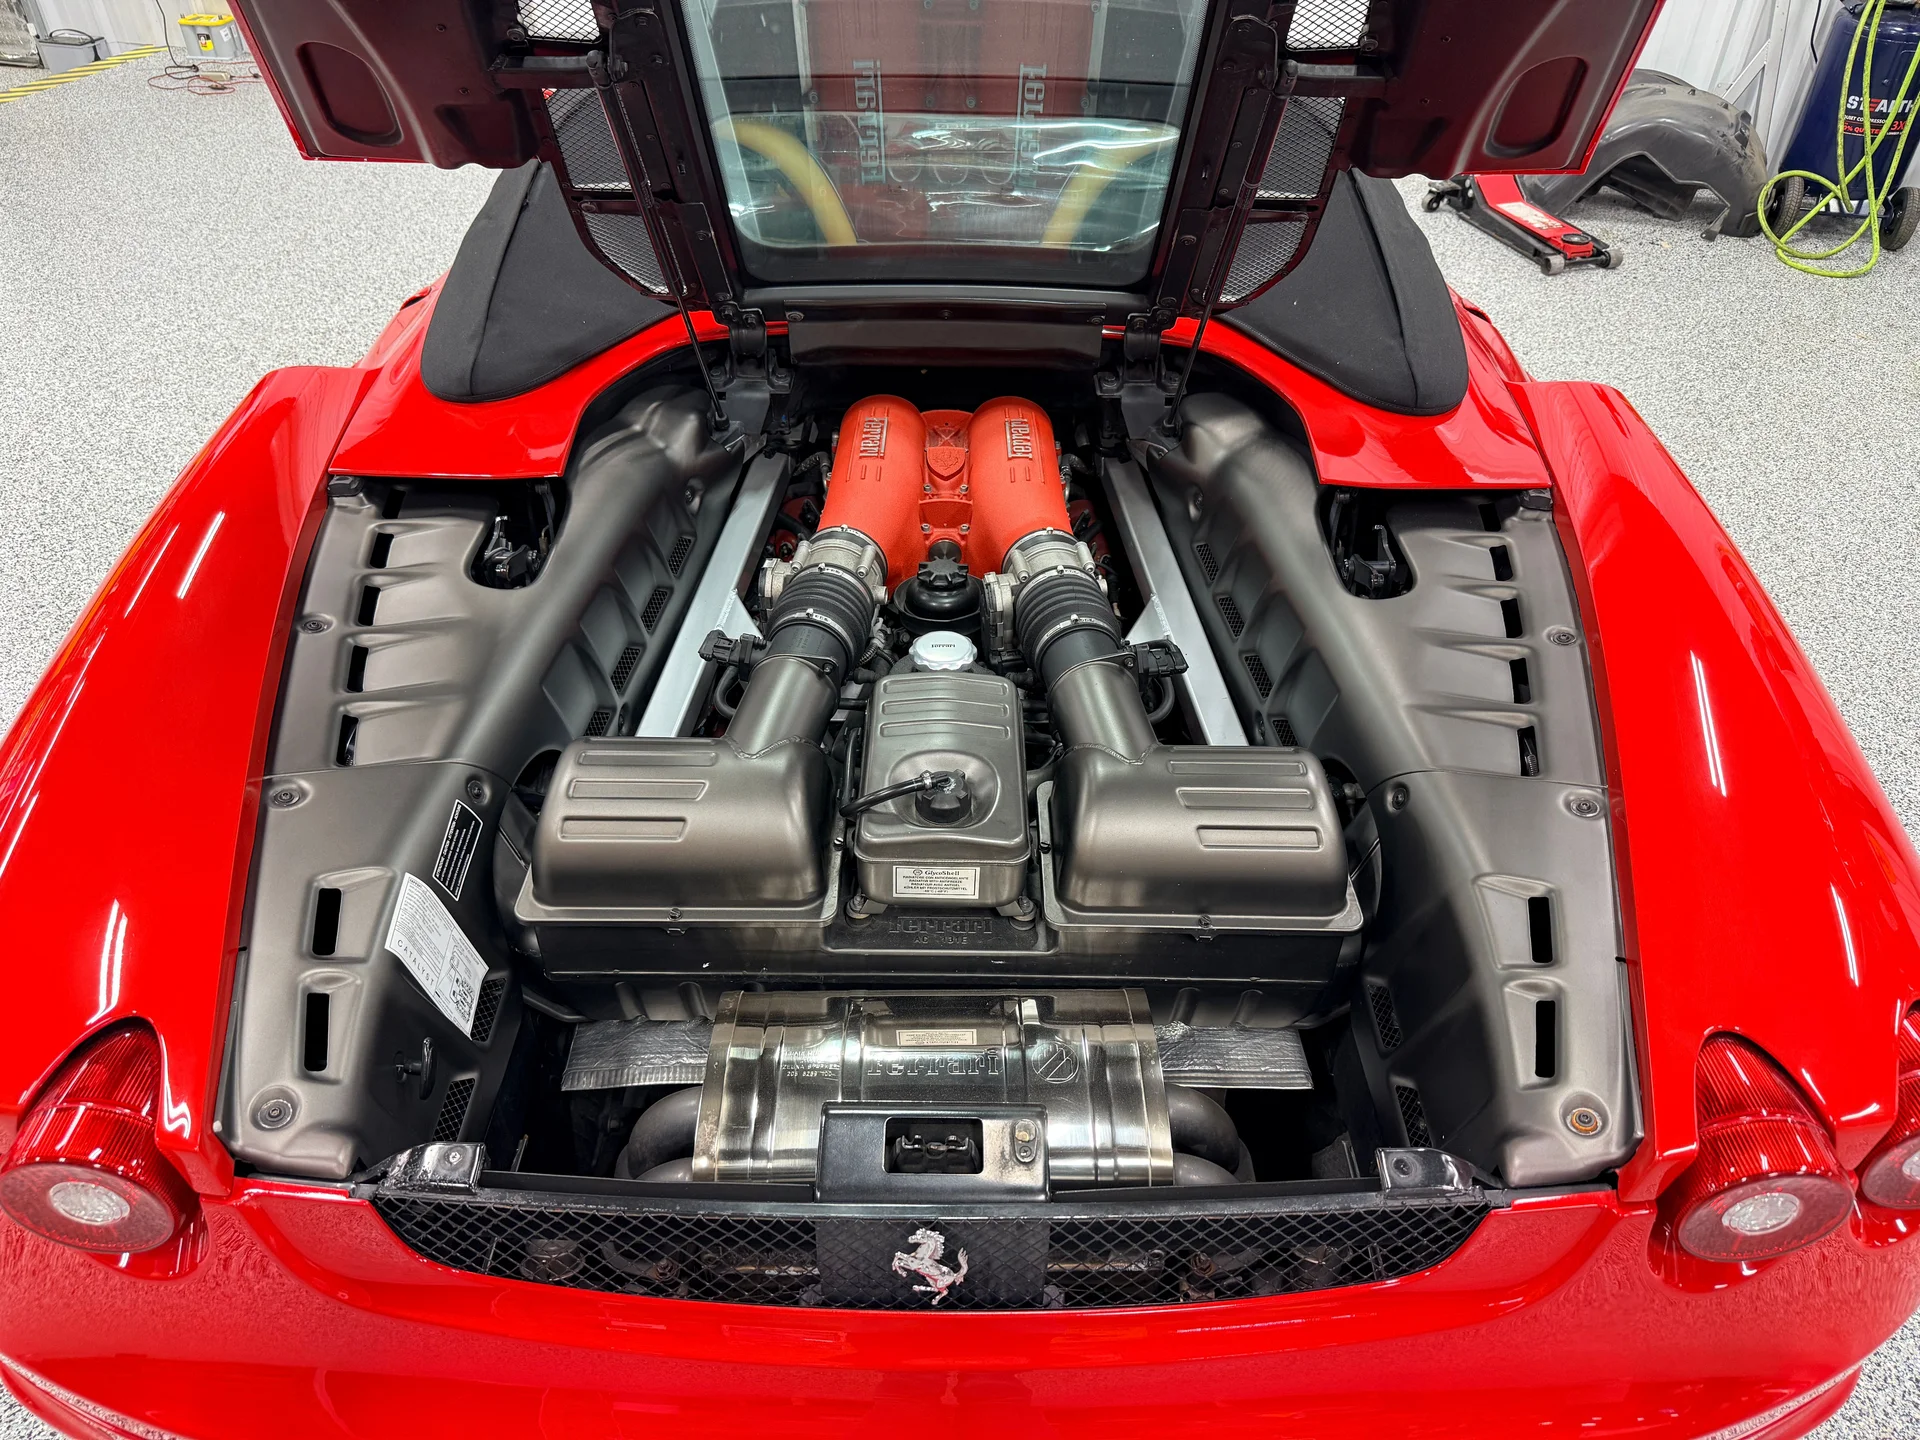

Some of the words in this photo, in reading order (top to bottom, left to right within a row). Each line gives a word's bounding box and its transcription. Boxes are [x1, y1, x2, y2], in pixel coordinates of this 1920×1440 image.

[859, 417, 887, 457] Ferrari
[1005, 418, 1032, 458] Ferrari
[889, 916, 993, 934] Ferrari
[397, 939, 435, 987] CATALYST
[867, 1048, 999, 1076] Ferrari
